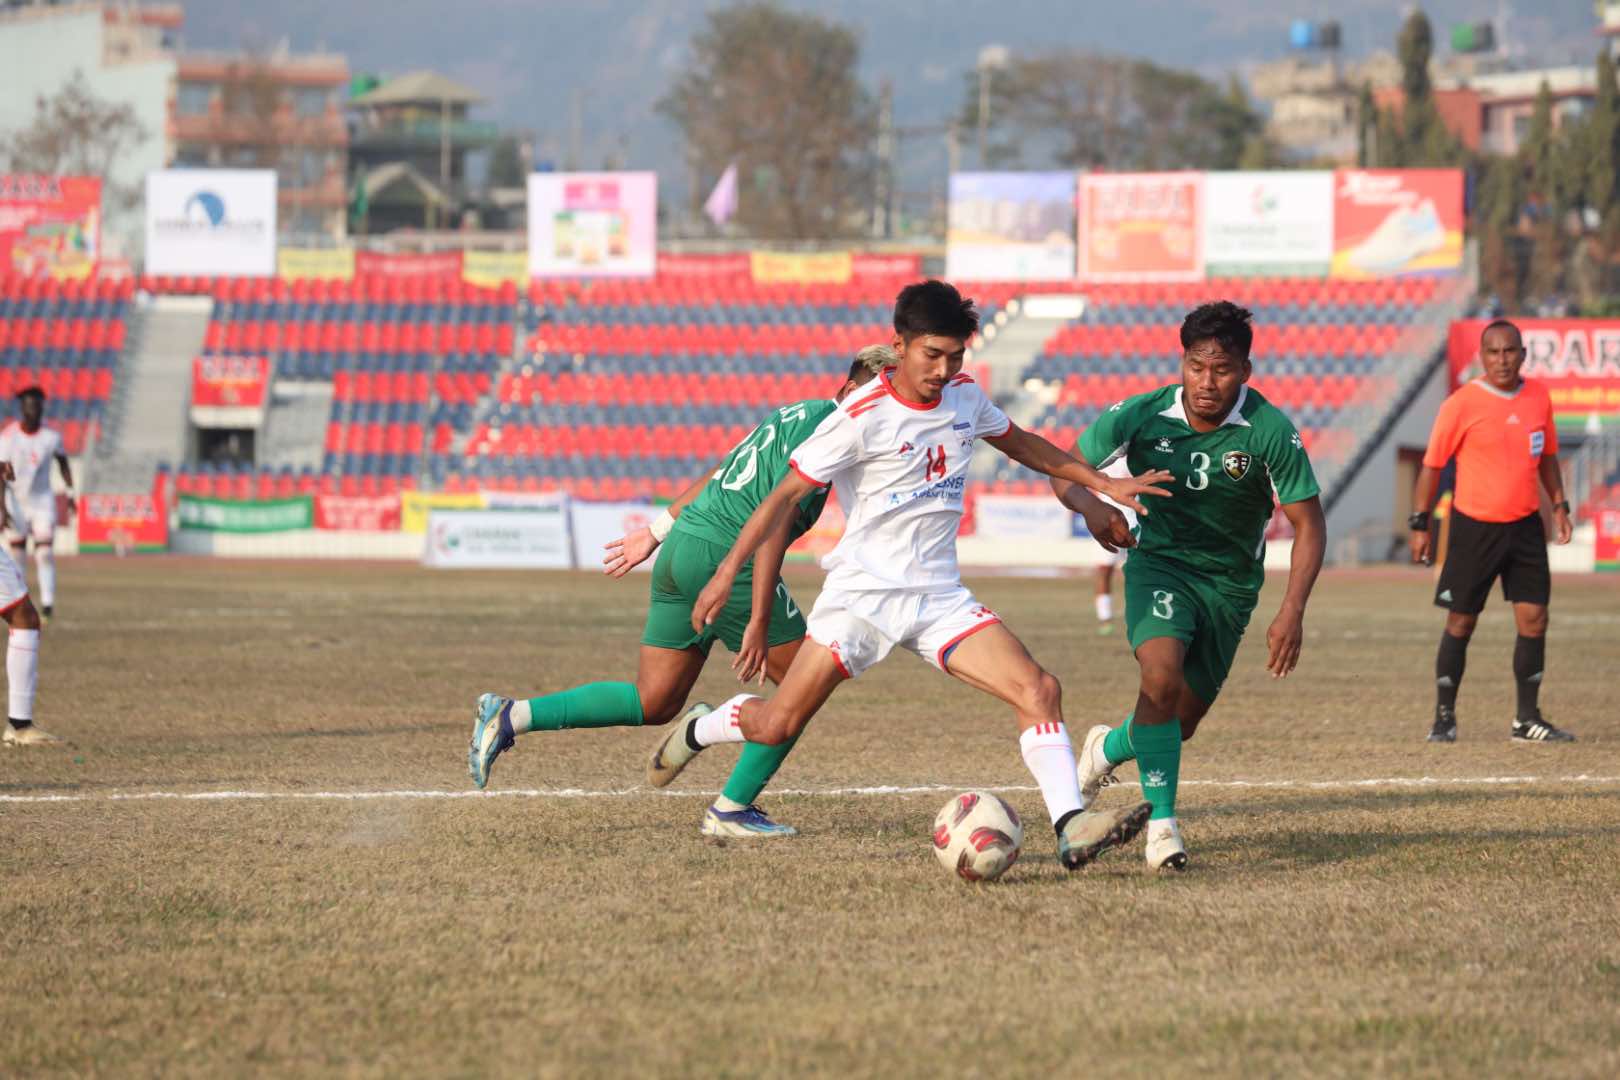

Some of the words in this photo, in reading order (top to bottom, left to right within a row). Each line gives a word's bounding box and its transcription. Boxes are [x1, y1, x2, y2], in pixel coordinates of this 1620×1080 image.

[925, 444, 947, 482] 14
[1185, 451, 1211, 491] 3
[1152, 590, 1174, 620] 3
